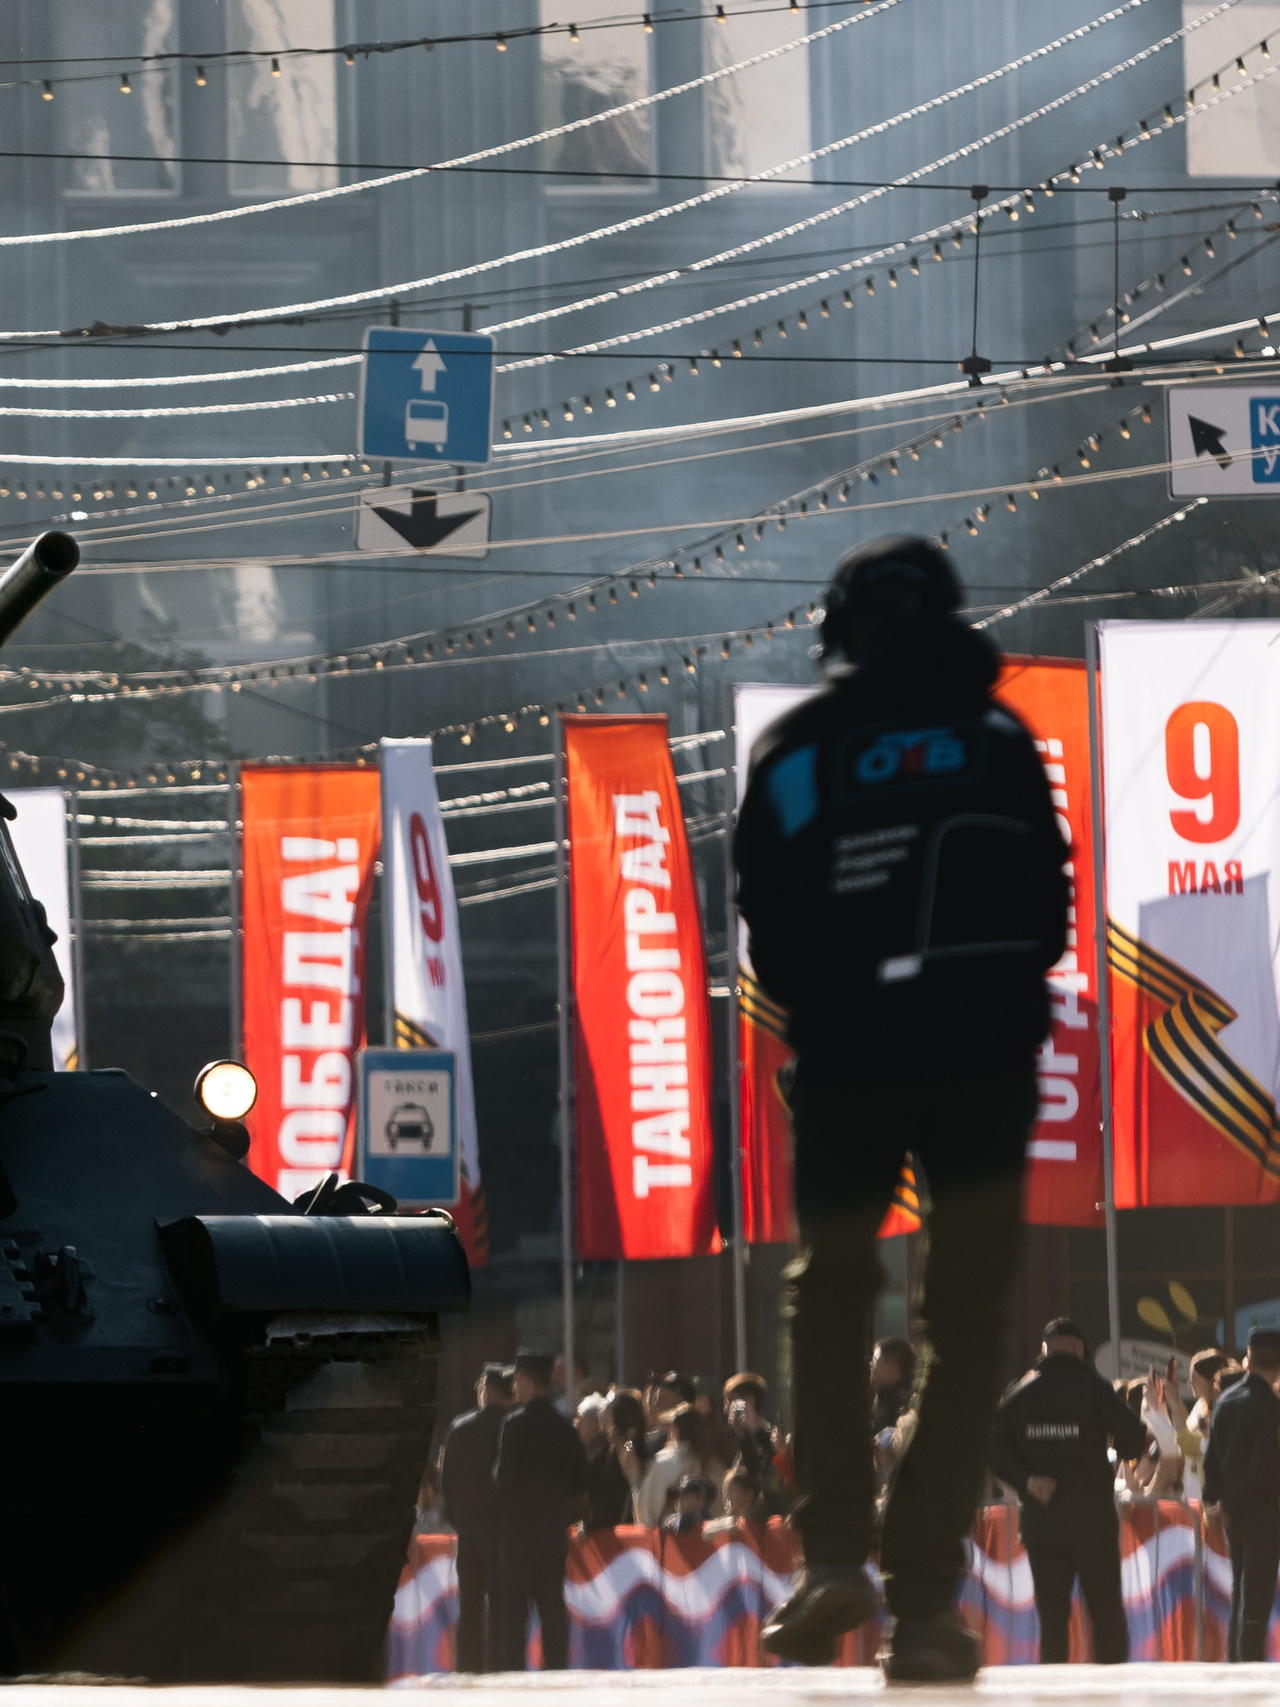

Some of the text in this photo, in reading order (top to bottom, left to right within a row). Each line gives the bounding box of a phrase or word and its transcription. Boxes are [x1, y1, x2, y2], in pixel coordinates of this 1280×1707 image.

[1165, 701, 1240, 844] 9
[409, 812, 443, 942] 9
[1168, 860, 1244, 896] МАЯ
[612, 790, 693, 1199] ТАНКОГРАД
